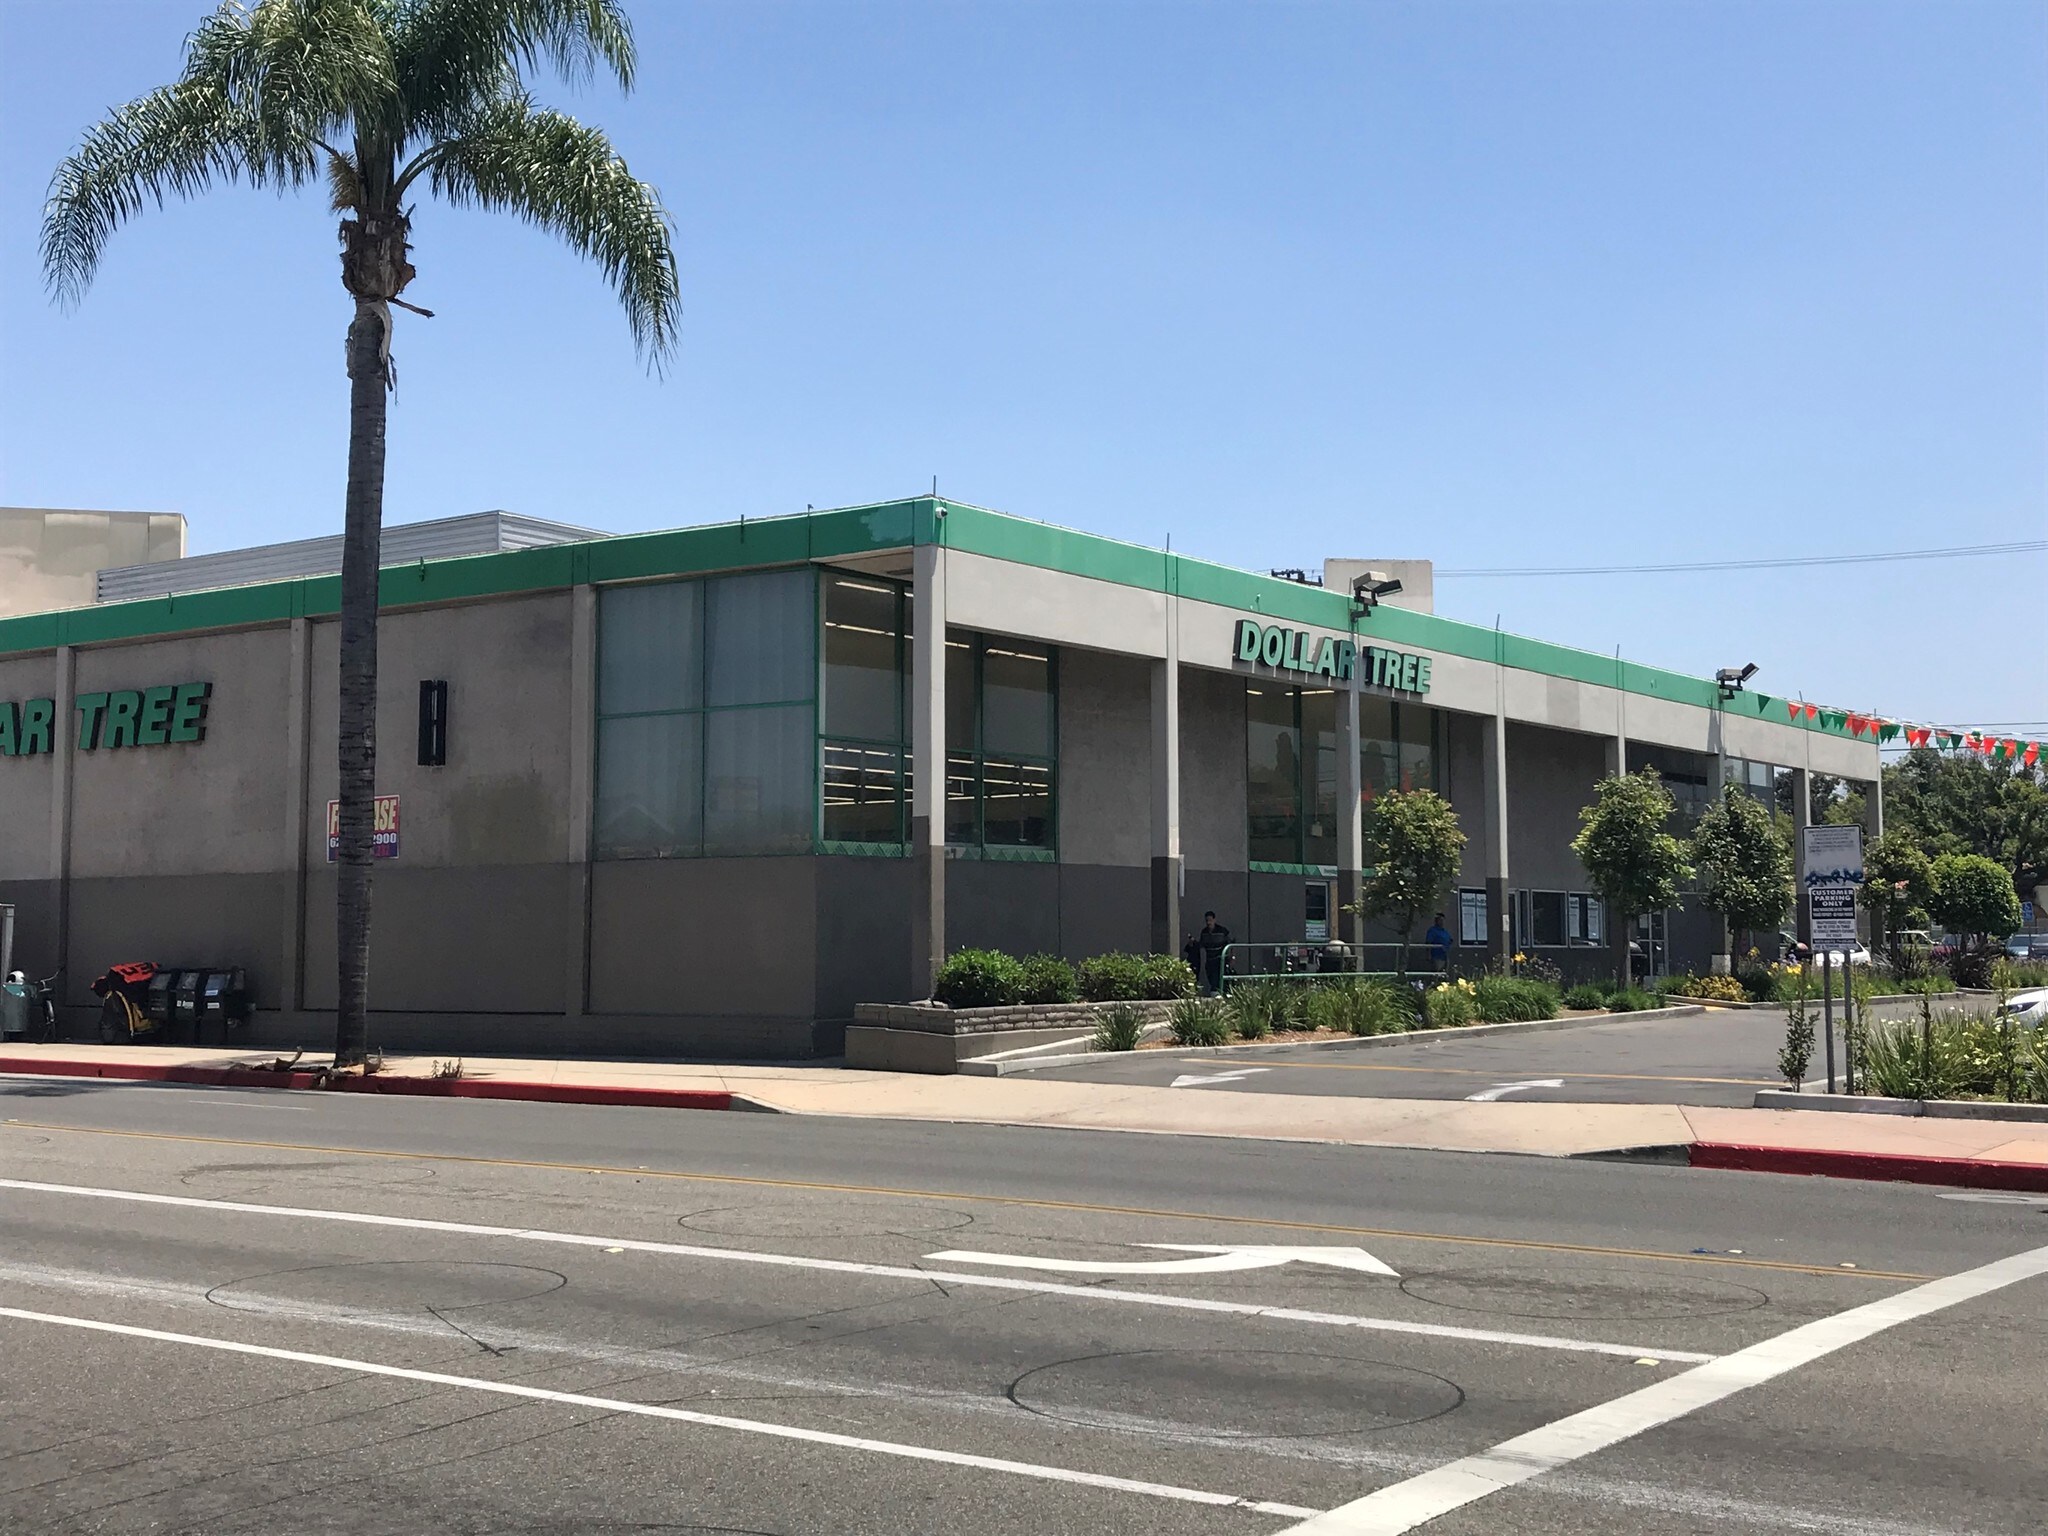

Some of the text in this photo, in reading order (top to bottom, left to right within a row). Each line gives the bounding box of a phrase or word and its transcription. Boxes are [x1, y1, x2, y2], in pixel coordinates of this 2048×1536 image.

[1234, 619, 1432, 694] DOLLAR TREE
[76, 682, 212, 749] TREE
